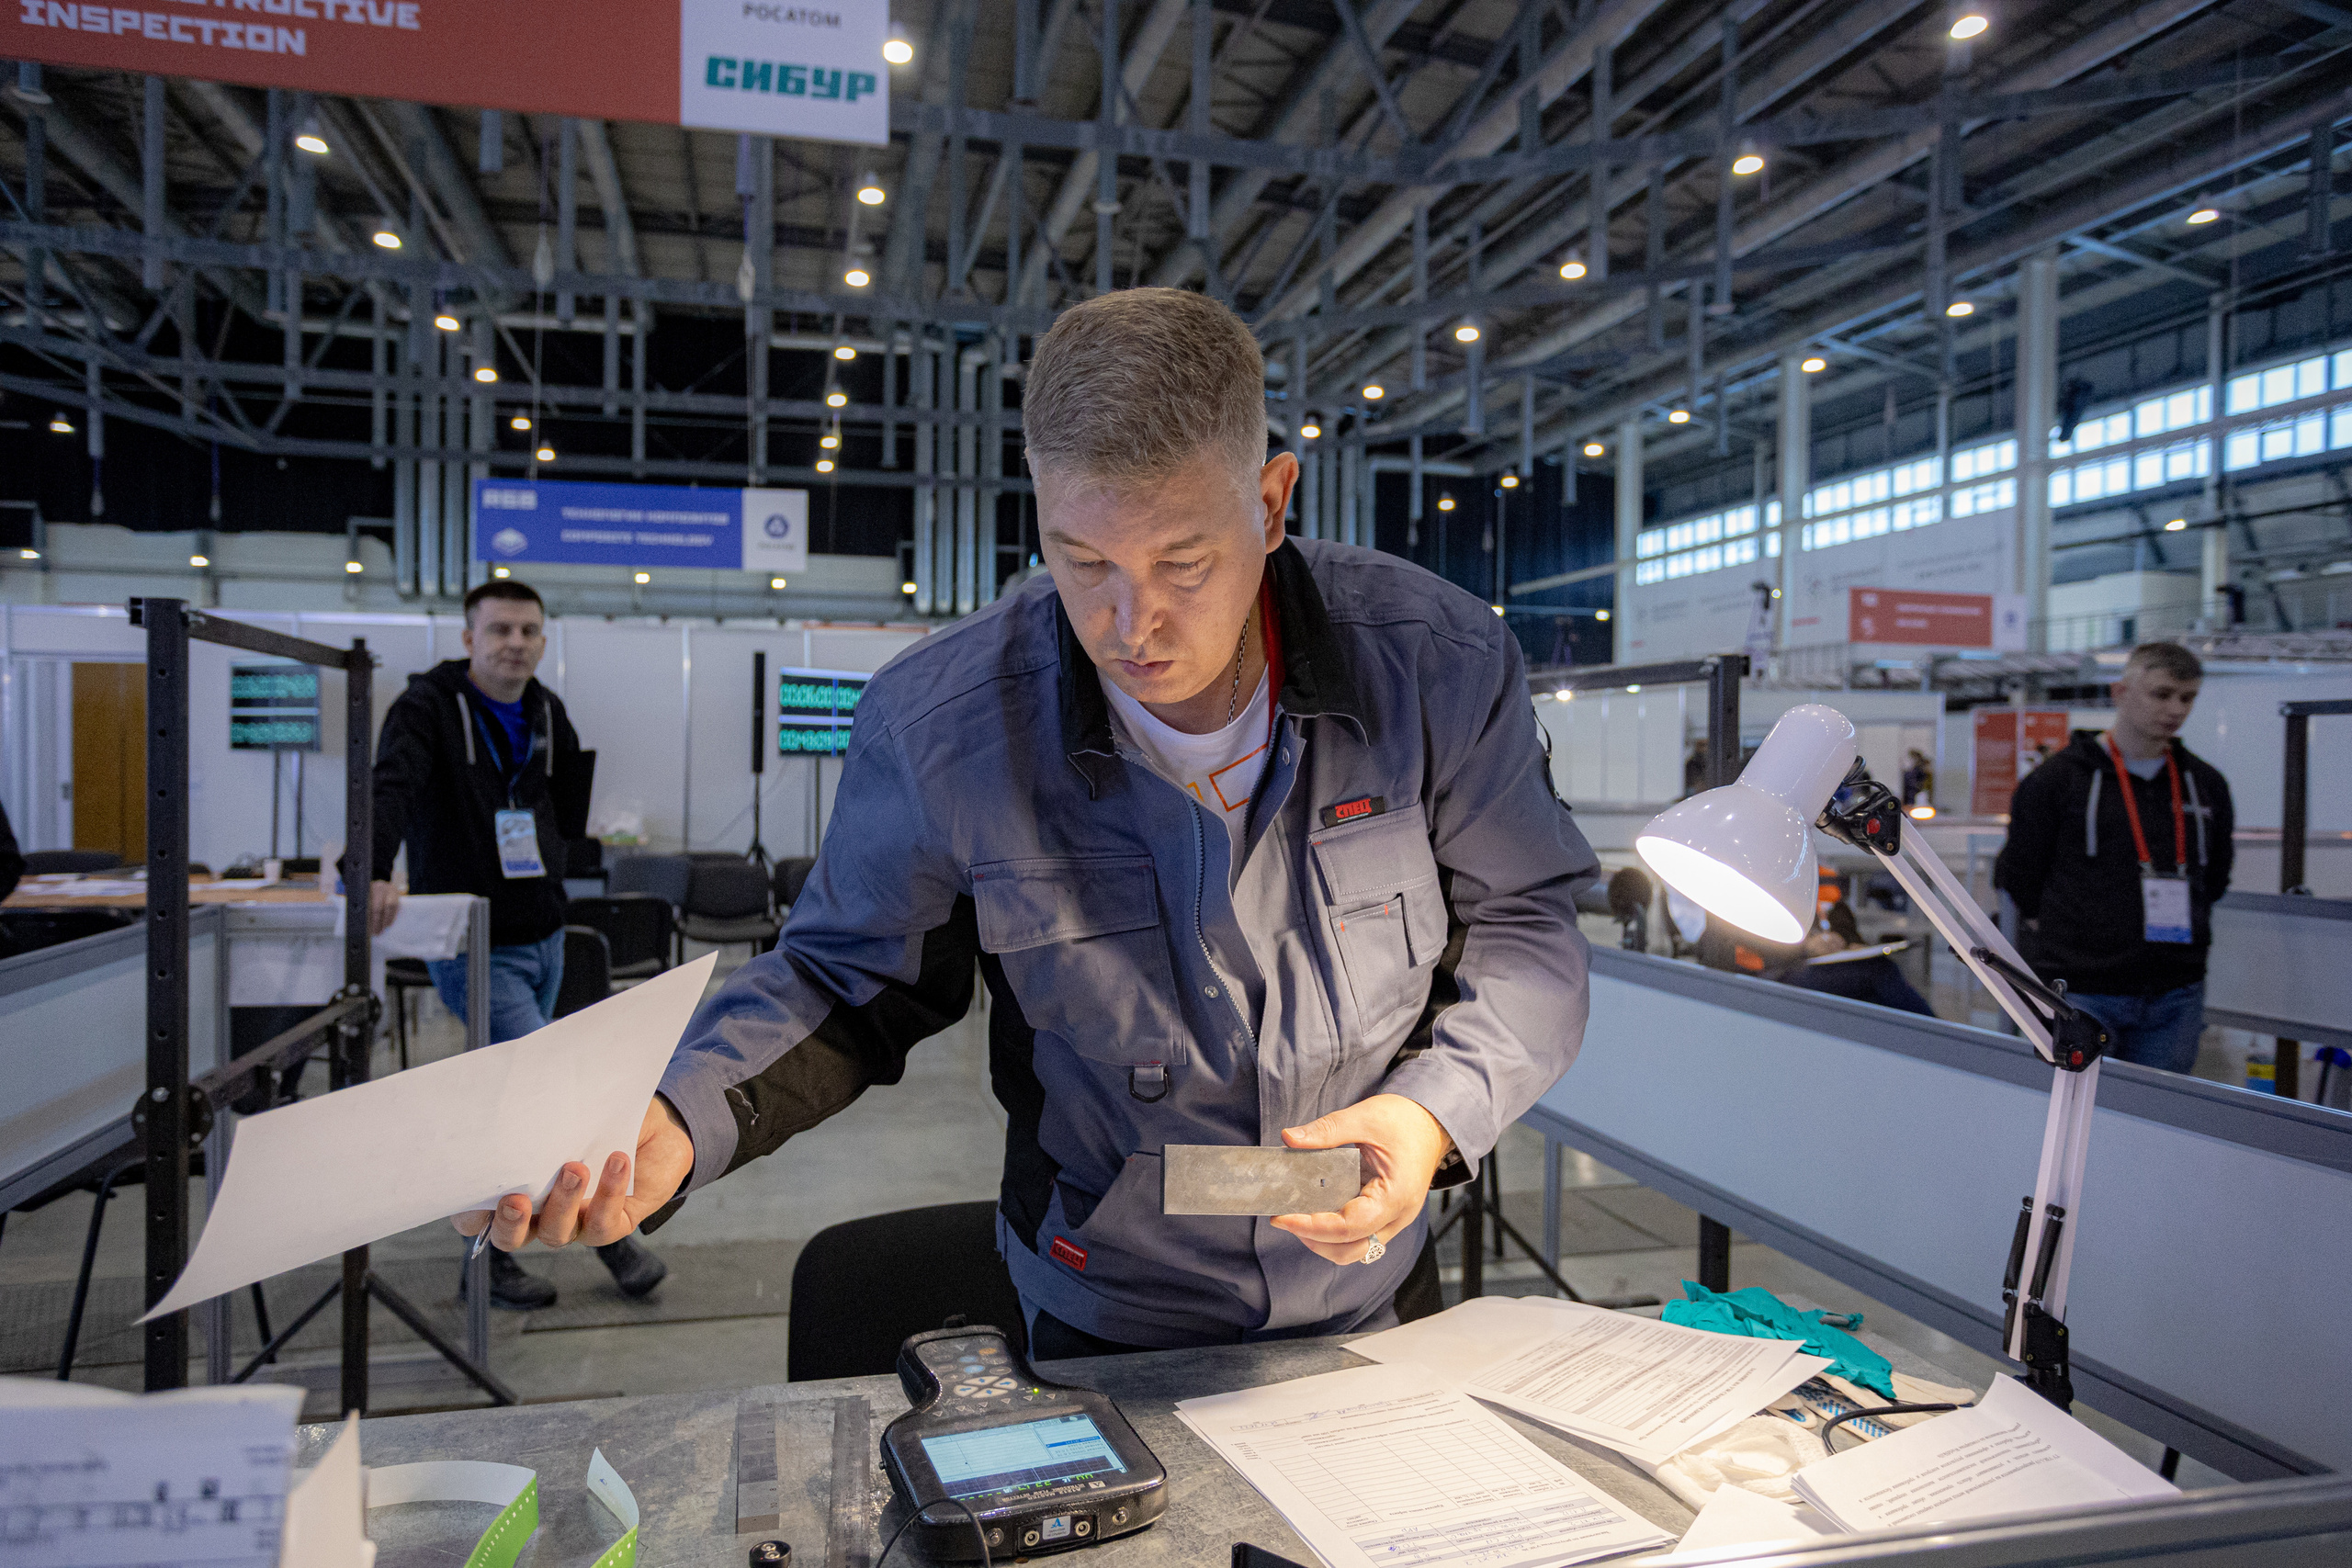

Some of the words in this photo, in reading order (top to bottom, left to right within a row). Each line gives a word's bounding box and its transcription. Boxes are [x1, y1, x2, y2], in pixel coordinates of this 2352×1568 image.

[20, 0, 307, 56] INSPECTION
[175, 0, 421, 29] UCTIVE
[742, 3, 842, 28] РОСАТОМ
[707, 55, 876, 102] СИБУР
